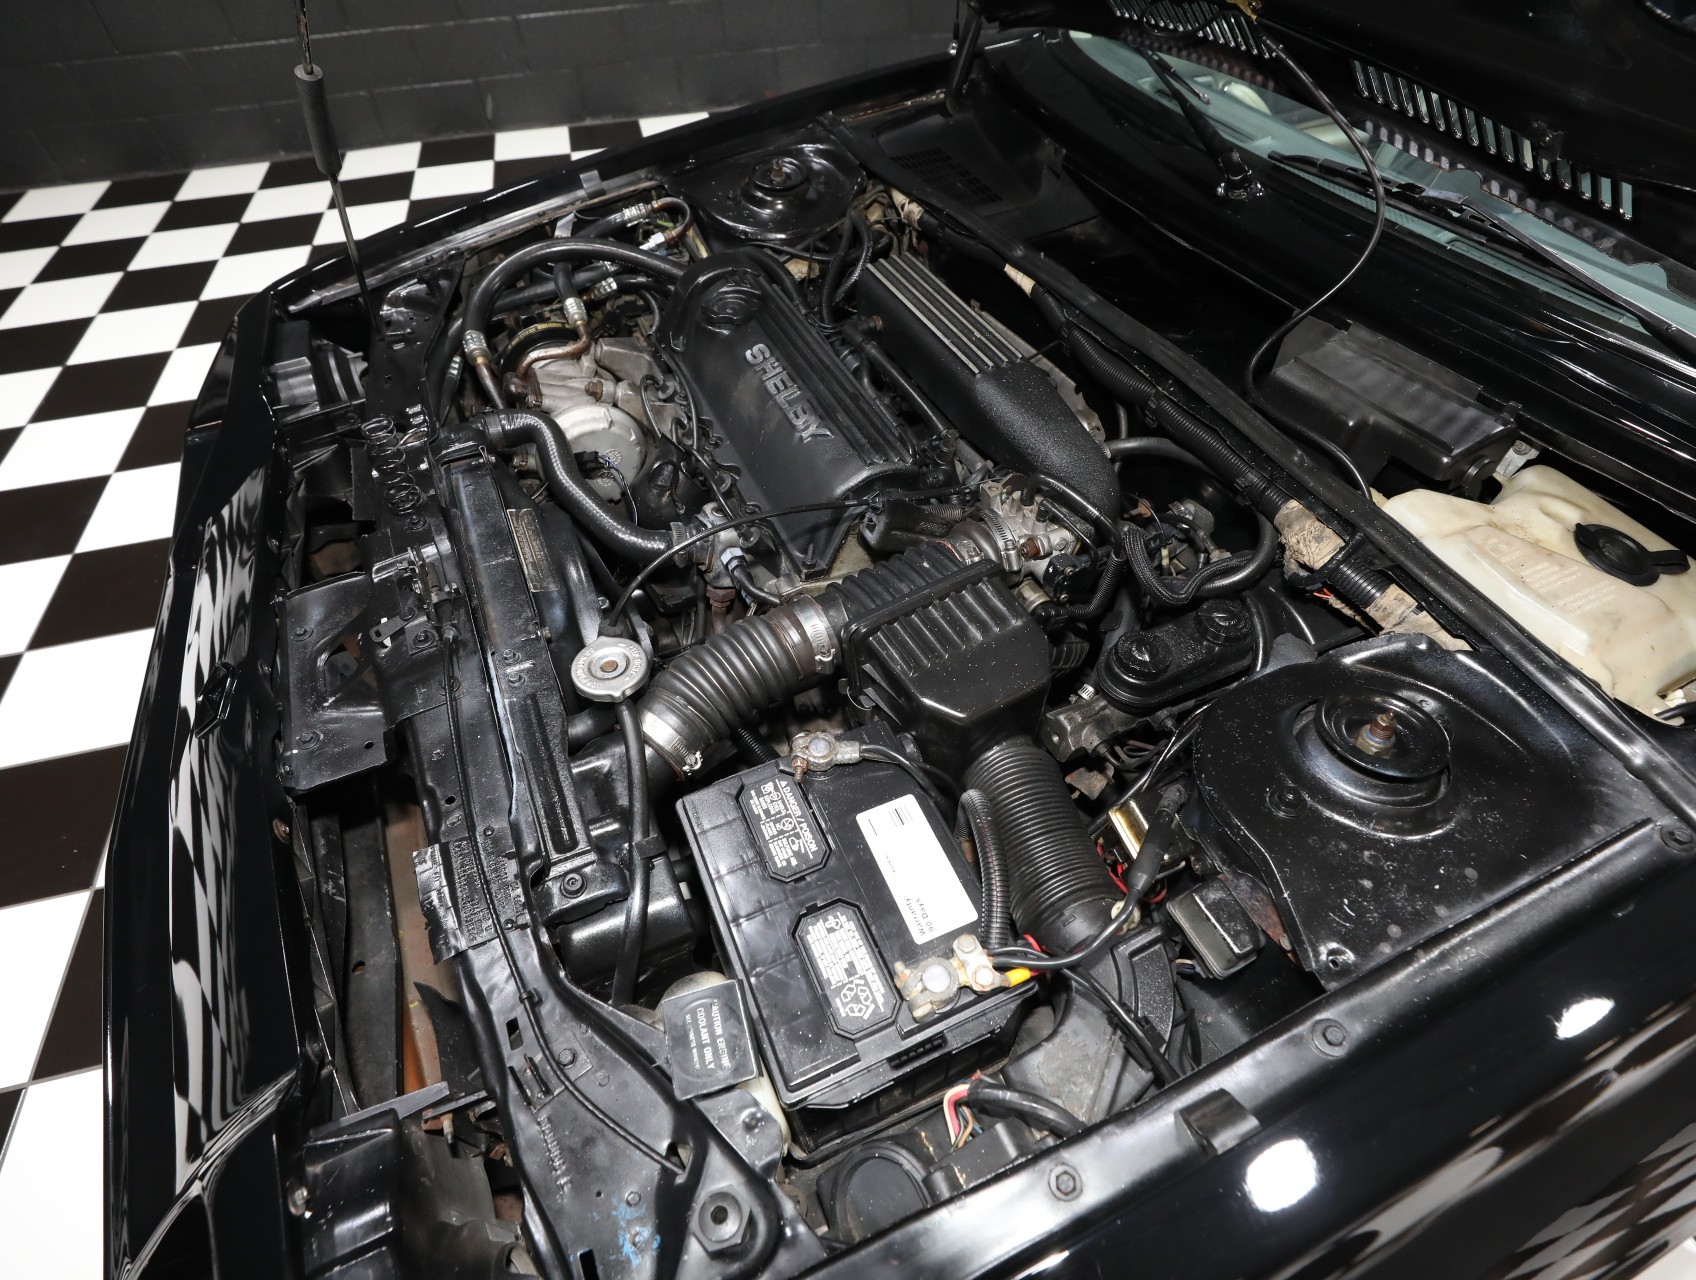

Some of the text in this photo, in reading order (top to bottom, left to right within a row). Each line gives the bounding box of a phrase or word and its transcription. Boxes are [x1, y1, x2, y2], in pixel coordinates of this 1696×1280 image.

[745, 343, 834, 443] SHELBY
[783, 786, 802, 818] DANGER
[799, 822, 819, 852] POISON
[916, 898, 936, 933] 90 Days
[696, 1007, 716, 1070] COOLANT ONLY
